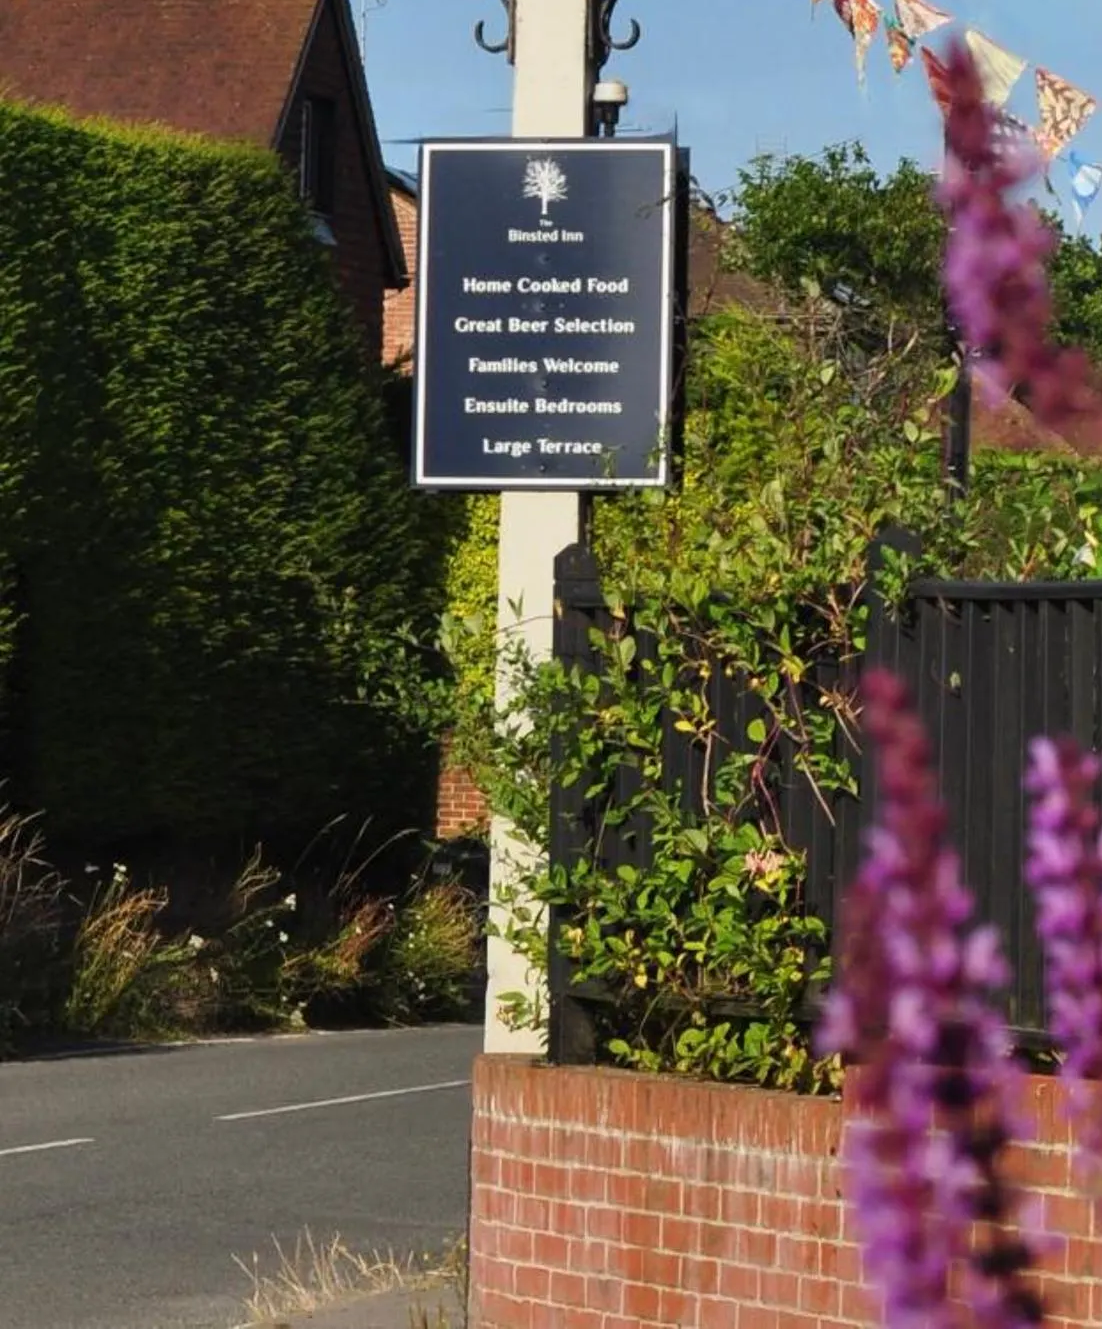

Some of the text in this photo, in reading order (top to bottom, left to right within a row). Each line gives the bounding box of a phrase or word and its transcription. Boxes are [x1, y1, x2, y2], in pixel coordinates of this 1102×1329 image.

[508, 229, 584, 242] Binsted Inn
[463, 277, 629, 293] Home Cooked Food
[454, 316, 635, 333] Great Beer Selection
[468, 357, 620, 374] Families Welcome
[464, 397, 623, 414] Ensuite Bedrooms
[483, 438, 602, 458] Large Terrace
